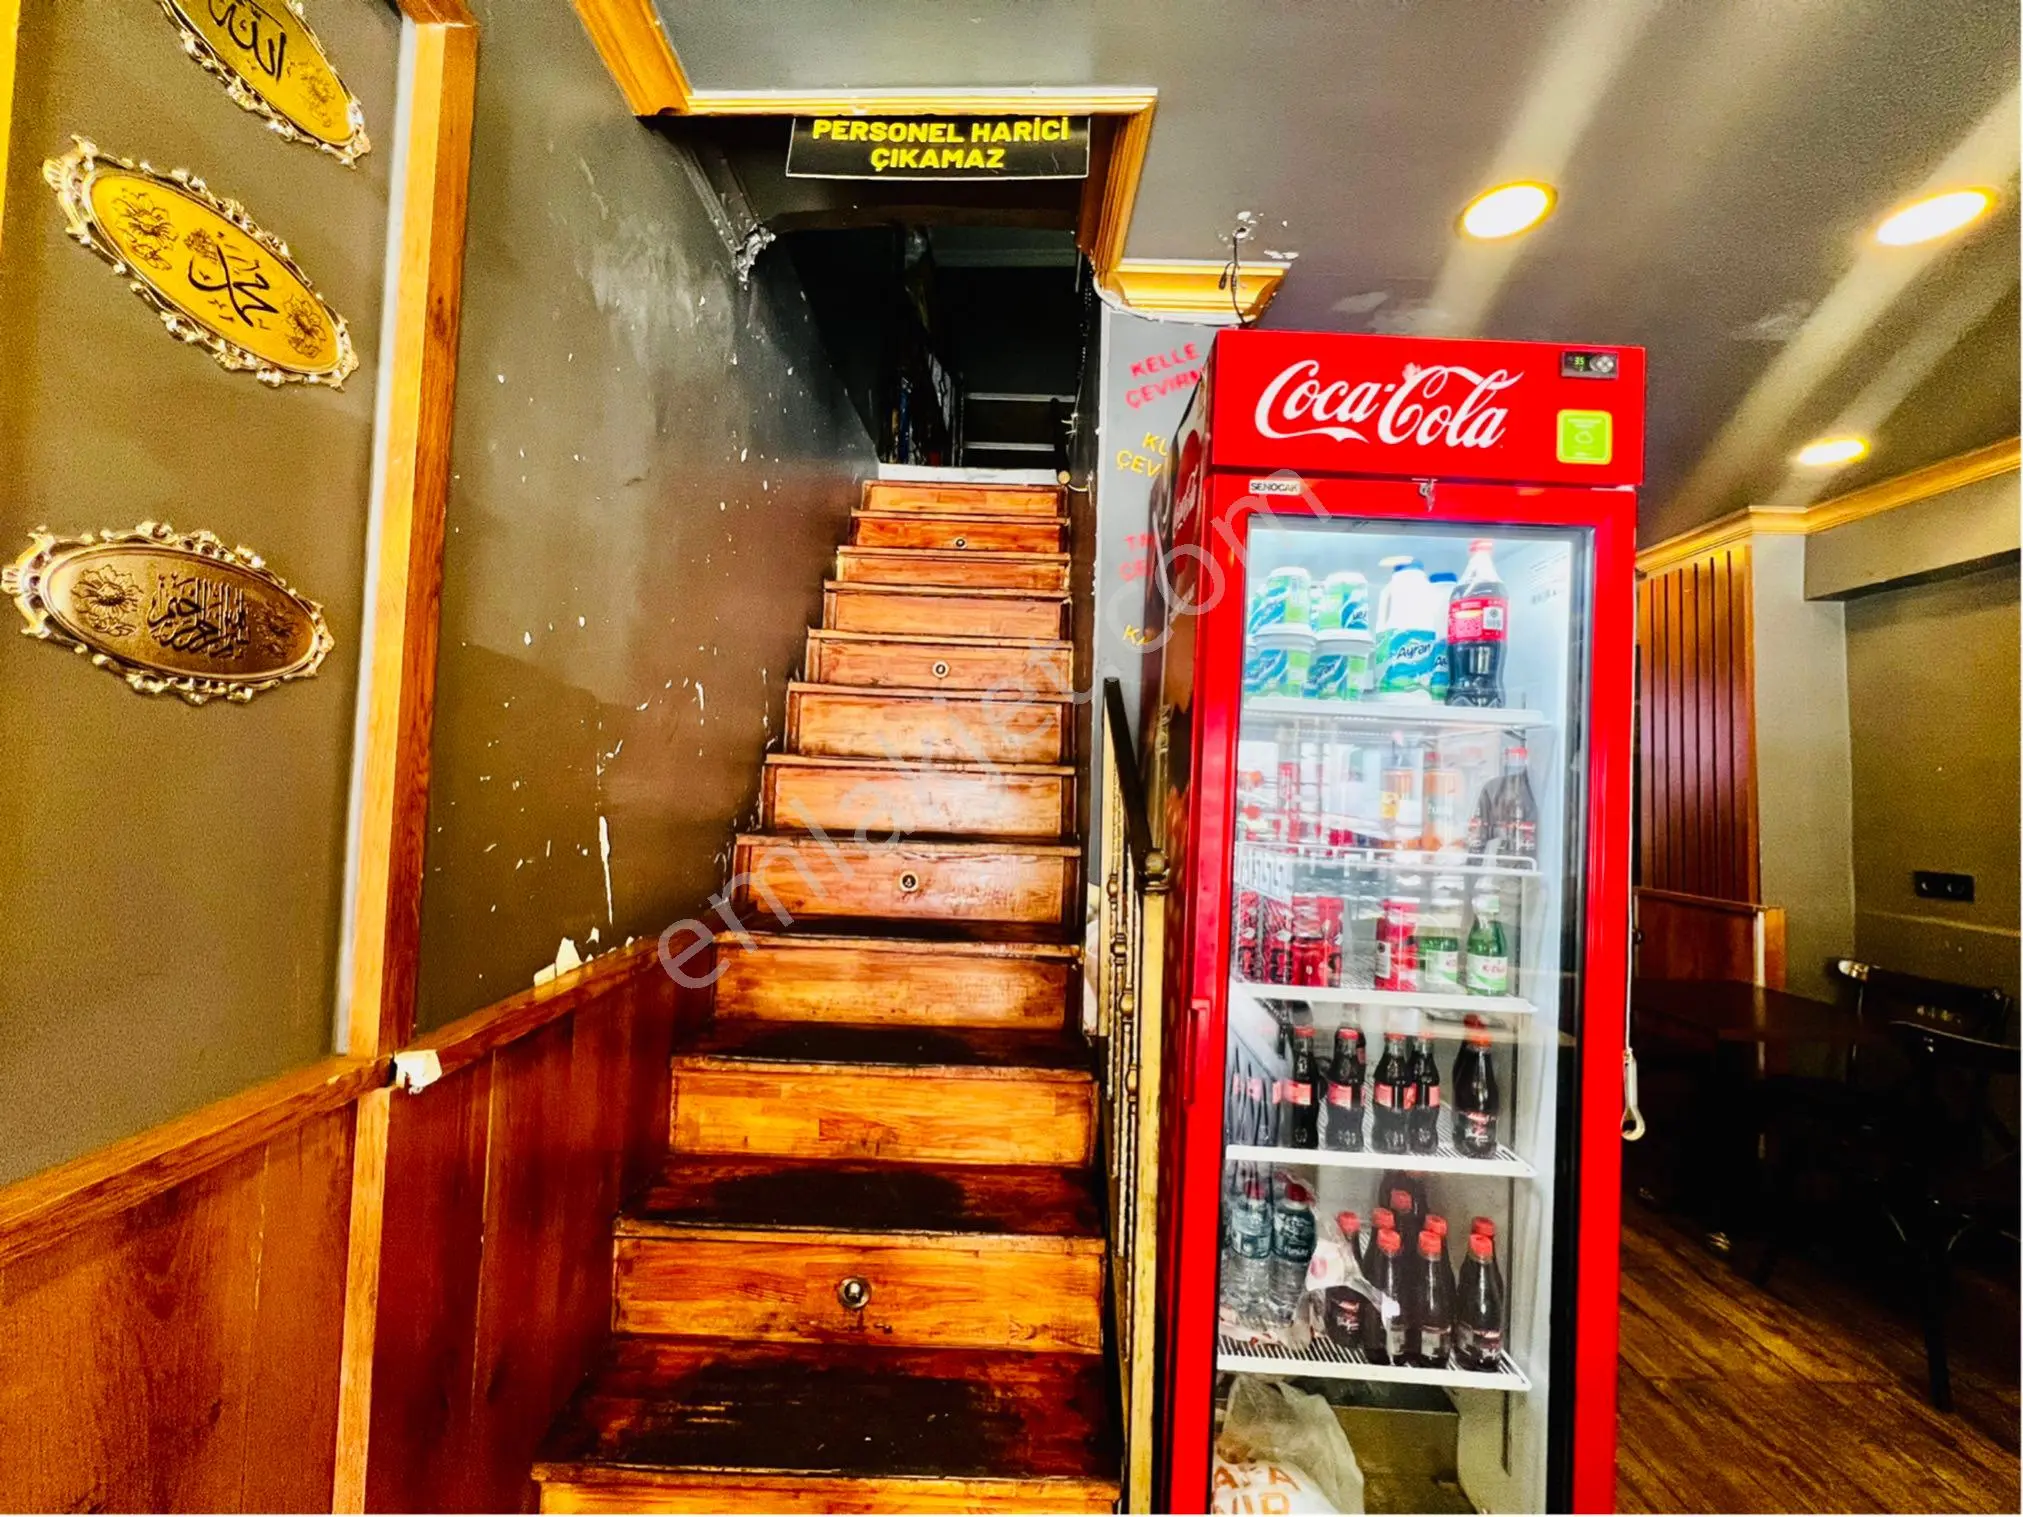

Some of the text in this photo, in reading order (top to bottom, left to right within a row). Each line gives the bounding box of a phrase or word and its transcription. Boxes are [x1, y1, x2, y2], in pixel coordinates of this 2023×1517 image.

[812, 116, 1071, 143] PERSONEL HARİCİ
[870, 147, 1007, 172] ÇIKAMAZ
[1129, 341, 1202, 379] KELLE
[1254, 359, 1525, 449] Coca-Cola
[1396, 642, 1431, 660] Ayran
